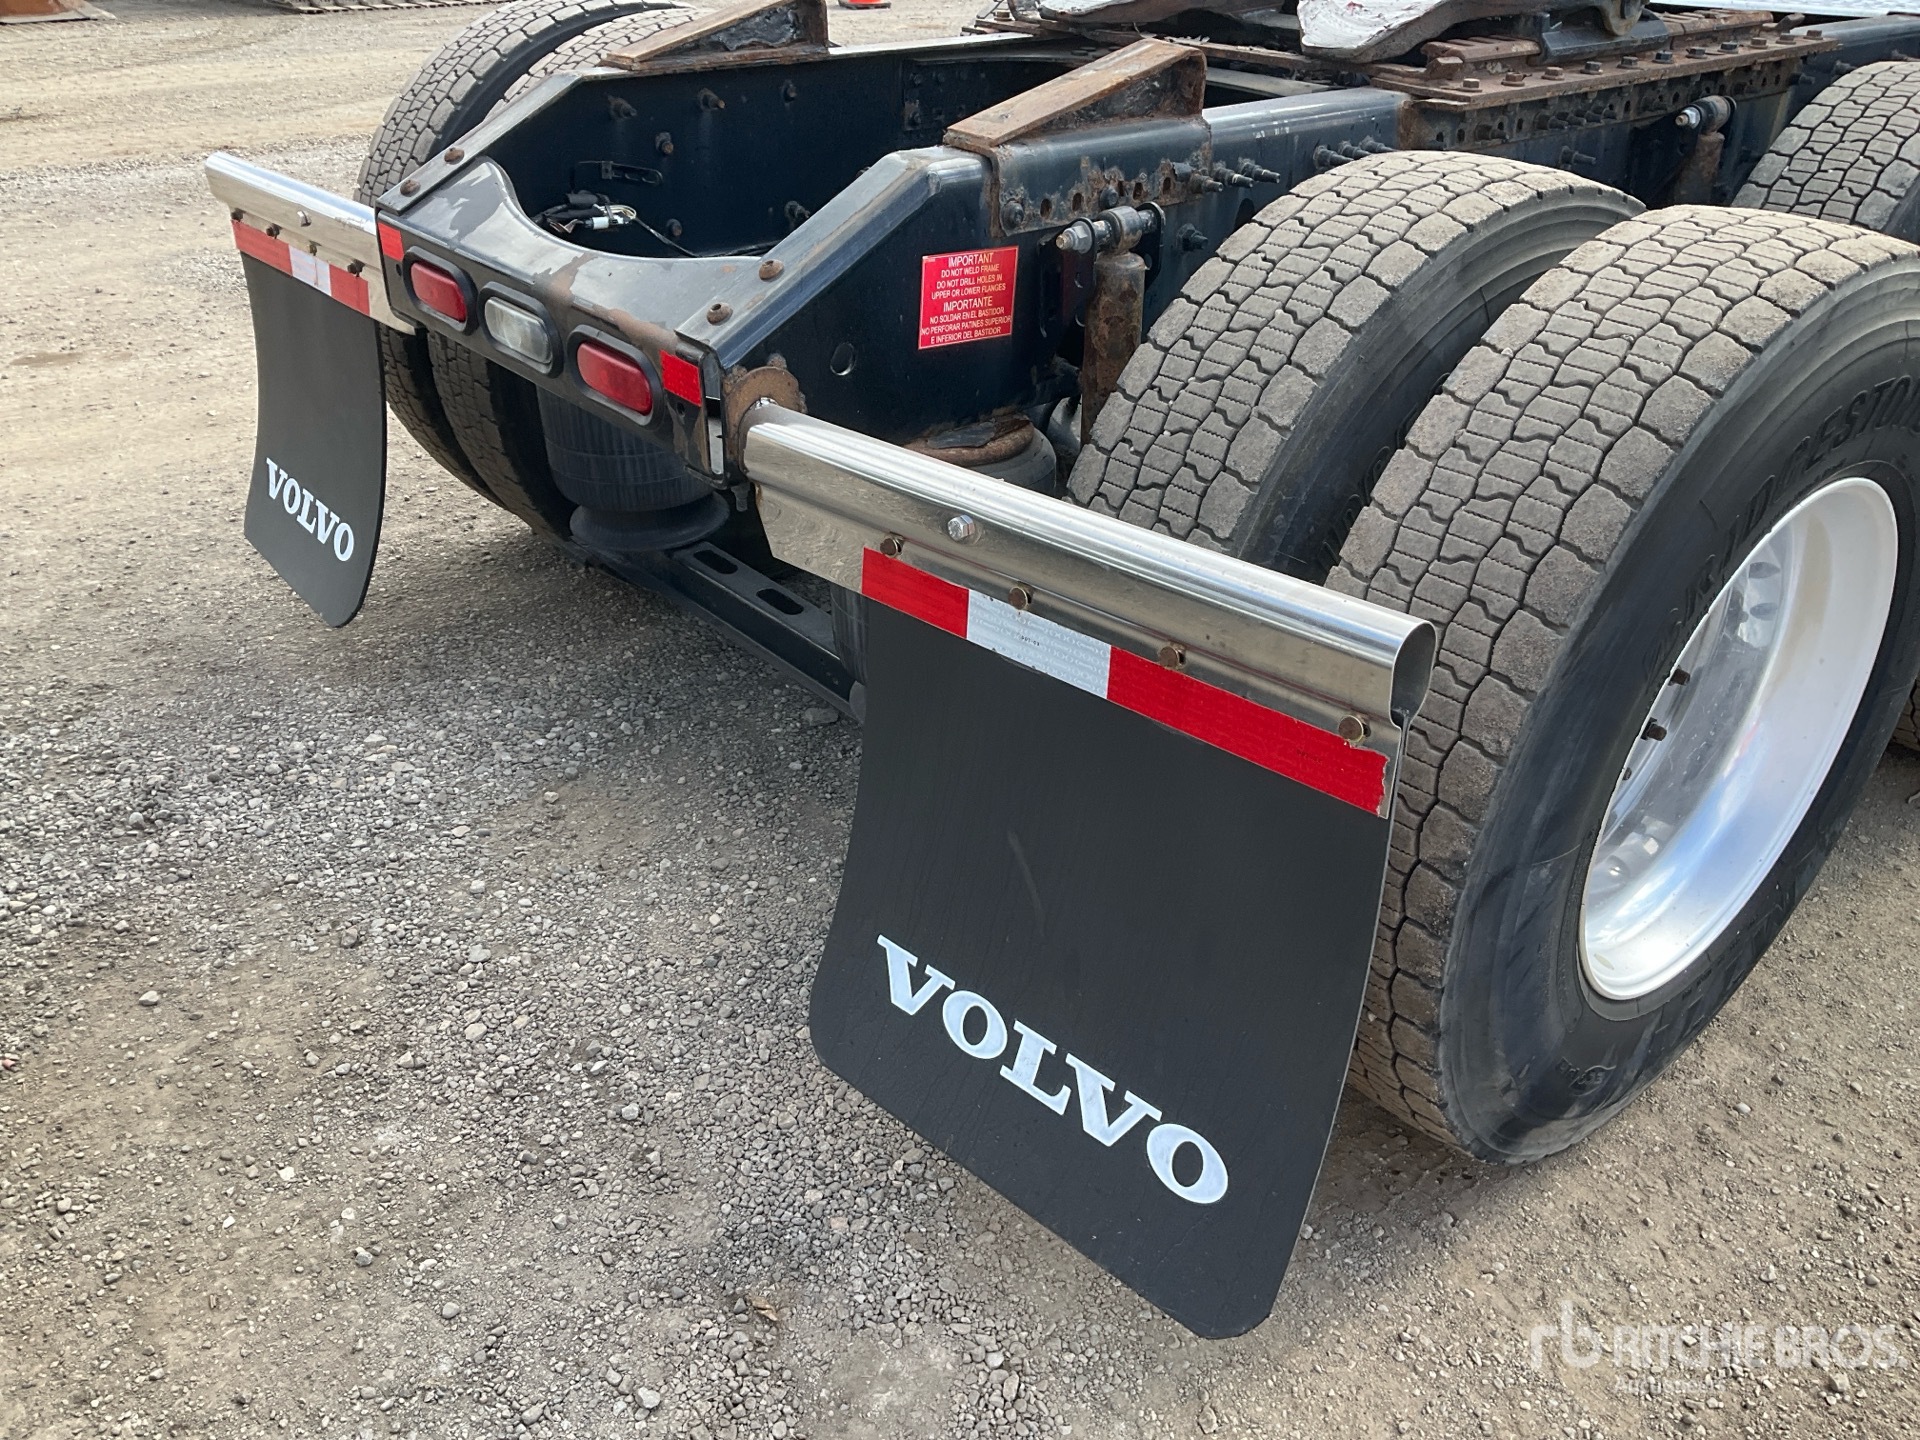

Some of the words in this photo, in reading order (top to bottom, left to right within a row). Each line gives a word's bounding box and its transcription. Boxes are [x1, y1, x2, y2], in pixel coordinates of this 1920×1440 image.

[949, 253, 994, 268] IMPORTANT
[942, 269, 951, 278] DO
[950, 268, 963, 276] NOT
[964, 266, 980, 275] WELD
[981, 263, 1000, 273] FRAME
[937, 281, 946, 290] DO
[946, 279, 960, 288] NOT
[960, 277, 976, 287] DRILL
[977, 274, 996, 284] HOLES
[997, 273, 1003, 281] IN
[932, 290, 951, 300] UPPER
[952, 288, 961, 297] OR
[960, 286, 981, 296] LOWER
[982, 282, 1006, 293] FLANGES
[944, 296, 993, 313] IMPORTANTE
[930, 316, 939, 325] NO
[940, 312, 962, 323] SOLDAR
[963, 311, 971, 319] EN
[971, 309, 978, 318] EL
[978, 306, 1005, 317] BASTIDOR
[921, 327, 931, 336] NO
[931, 323, 961, 334] PERFORAR
[962, 319, 984, 329] PATINES
[985, 315, 1012, 326] SUPERIOR
[931, 336, 935, 344] E
[936, 332, 963, 343] INFERIOR
[963, 330, 973, 338] DEL
[974, 326, 1002, 338] BASTIDOR
[266, 457, 355, 562] VOLVO
[877, 934, 1229, 1204] VOLVO
